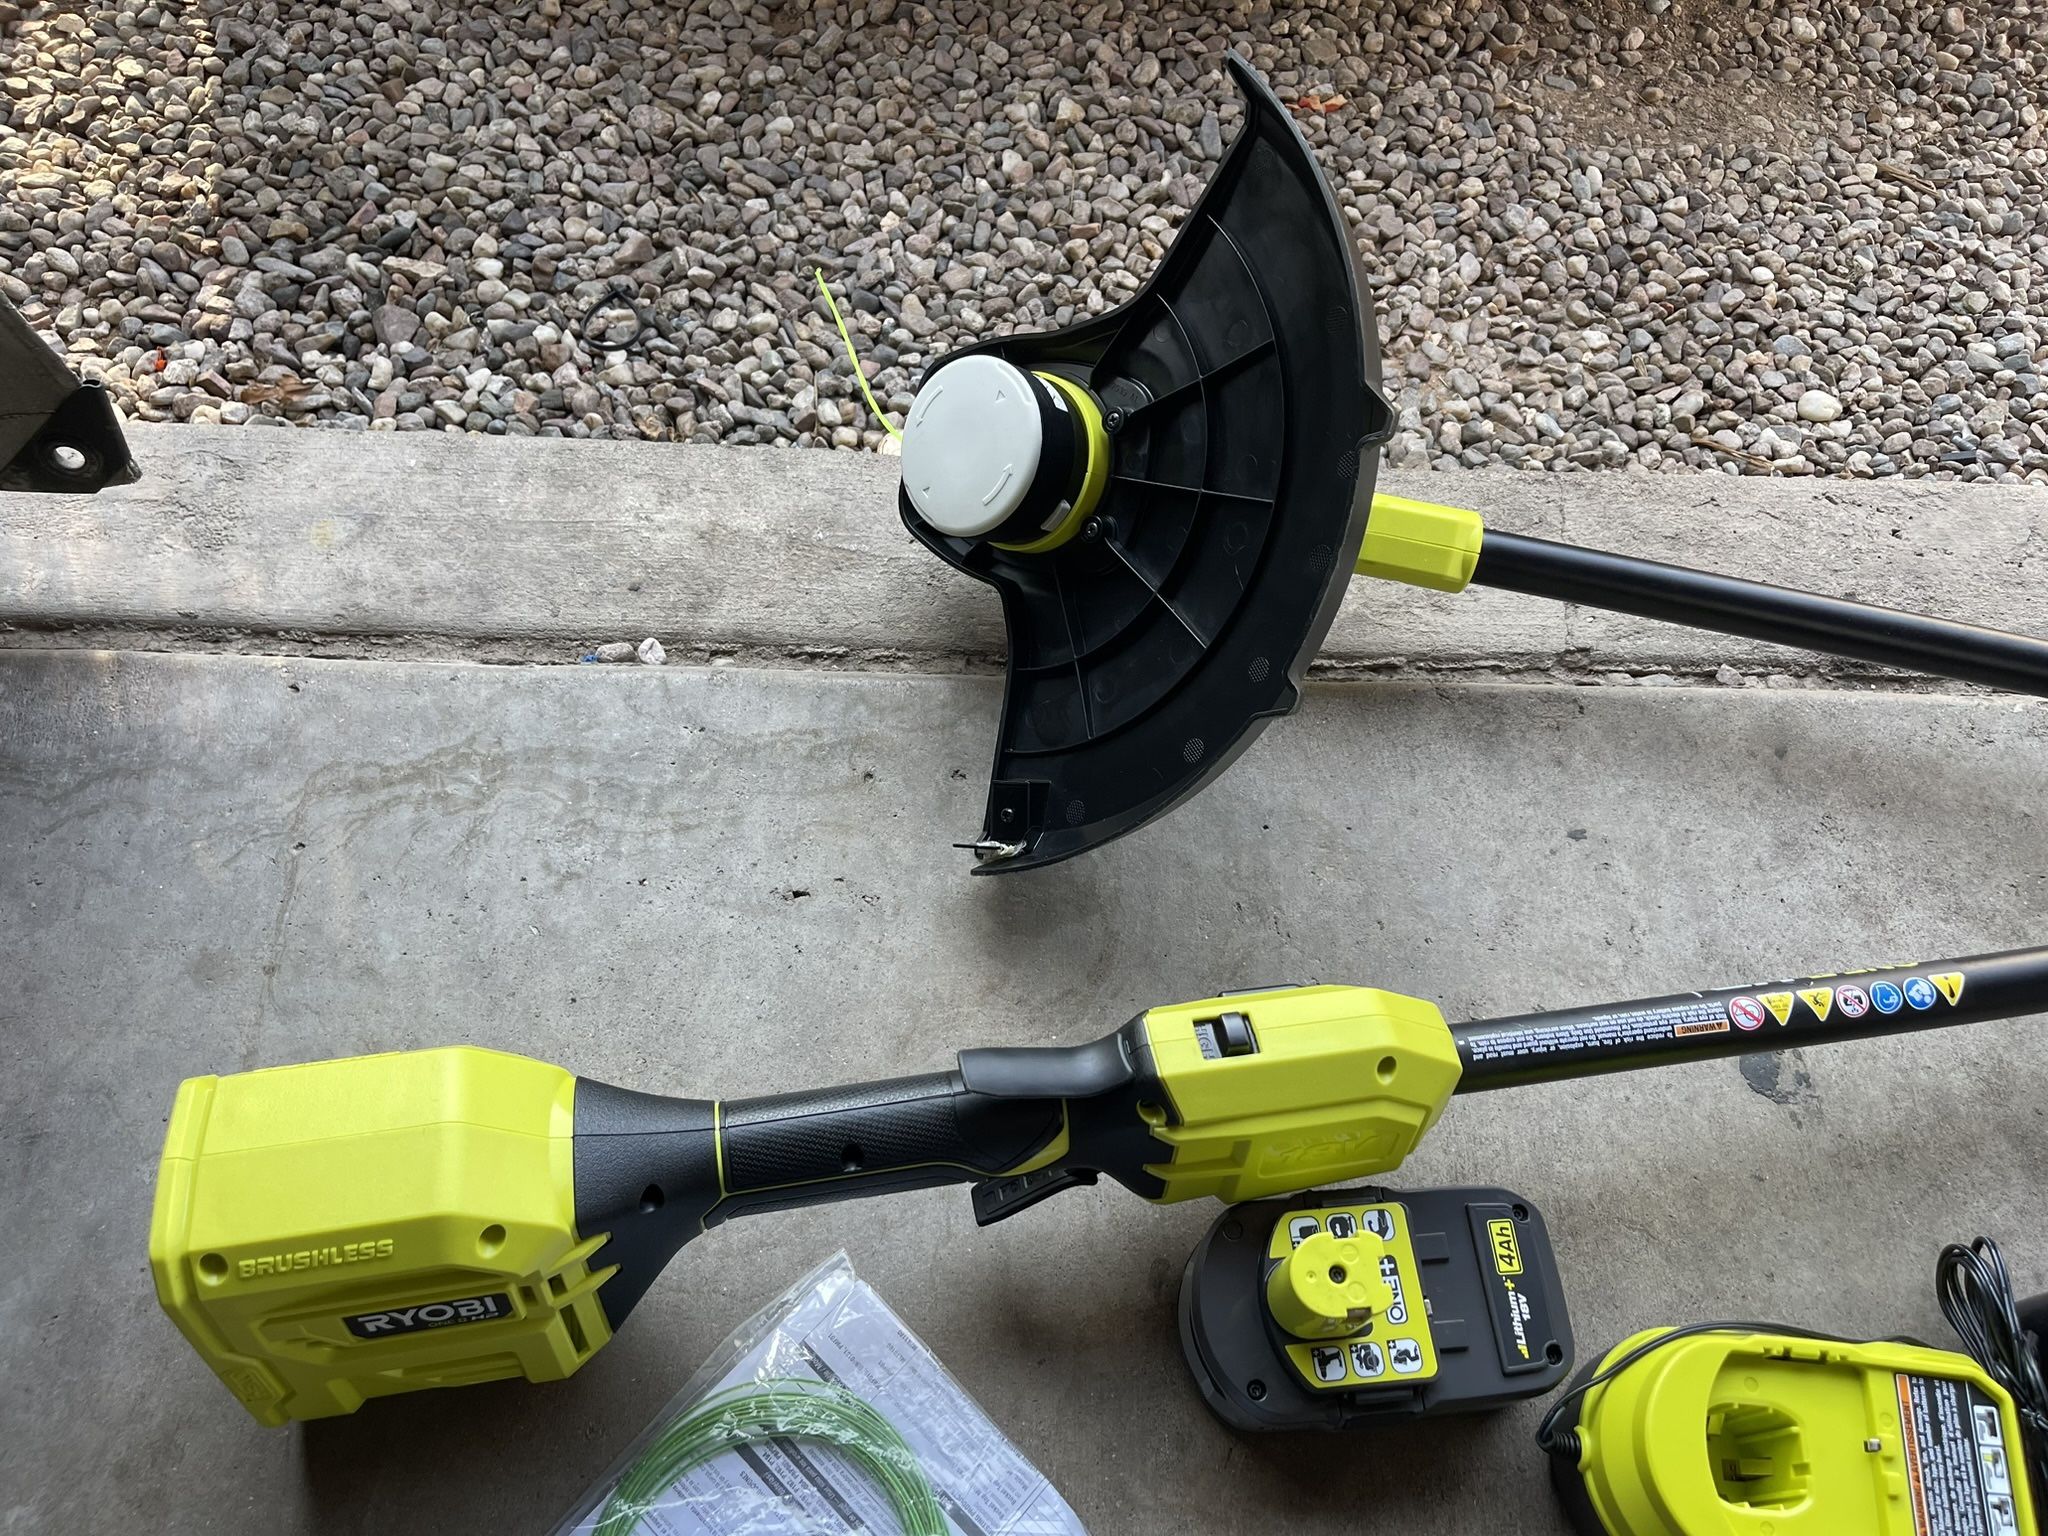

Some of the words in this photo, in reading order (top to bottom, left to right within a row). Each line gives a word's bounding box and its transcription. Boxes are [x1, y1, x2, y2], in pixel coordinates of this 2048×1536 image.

[1681, 1023, 1716, 1034] WARNING
[238, 1238, 394, 1278] BRUSHLESS
[1498, 1227, 1516, 1267] 4Ah
[358, 1296, 498, 1333] RYOBI
[1516, 1293, 1530, 1321] 18V
